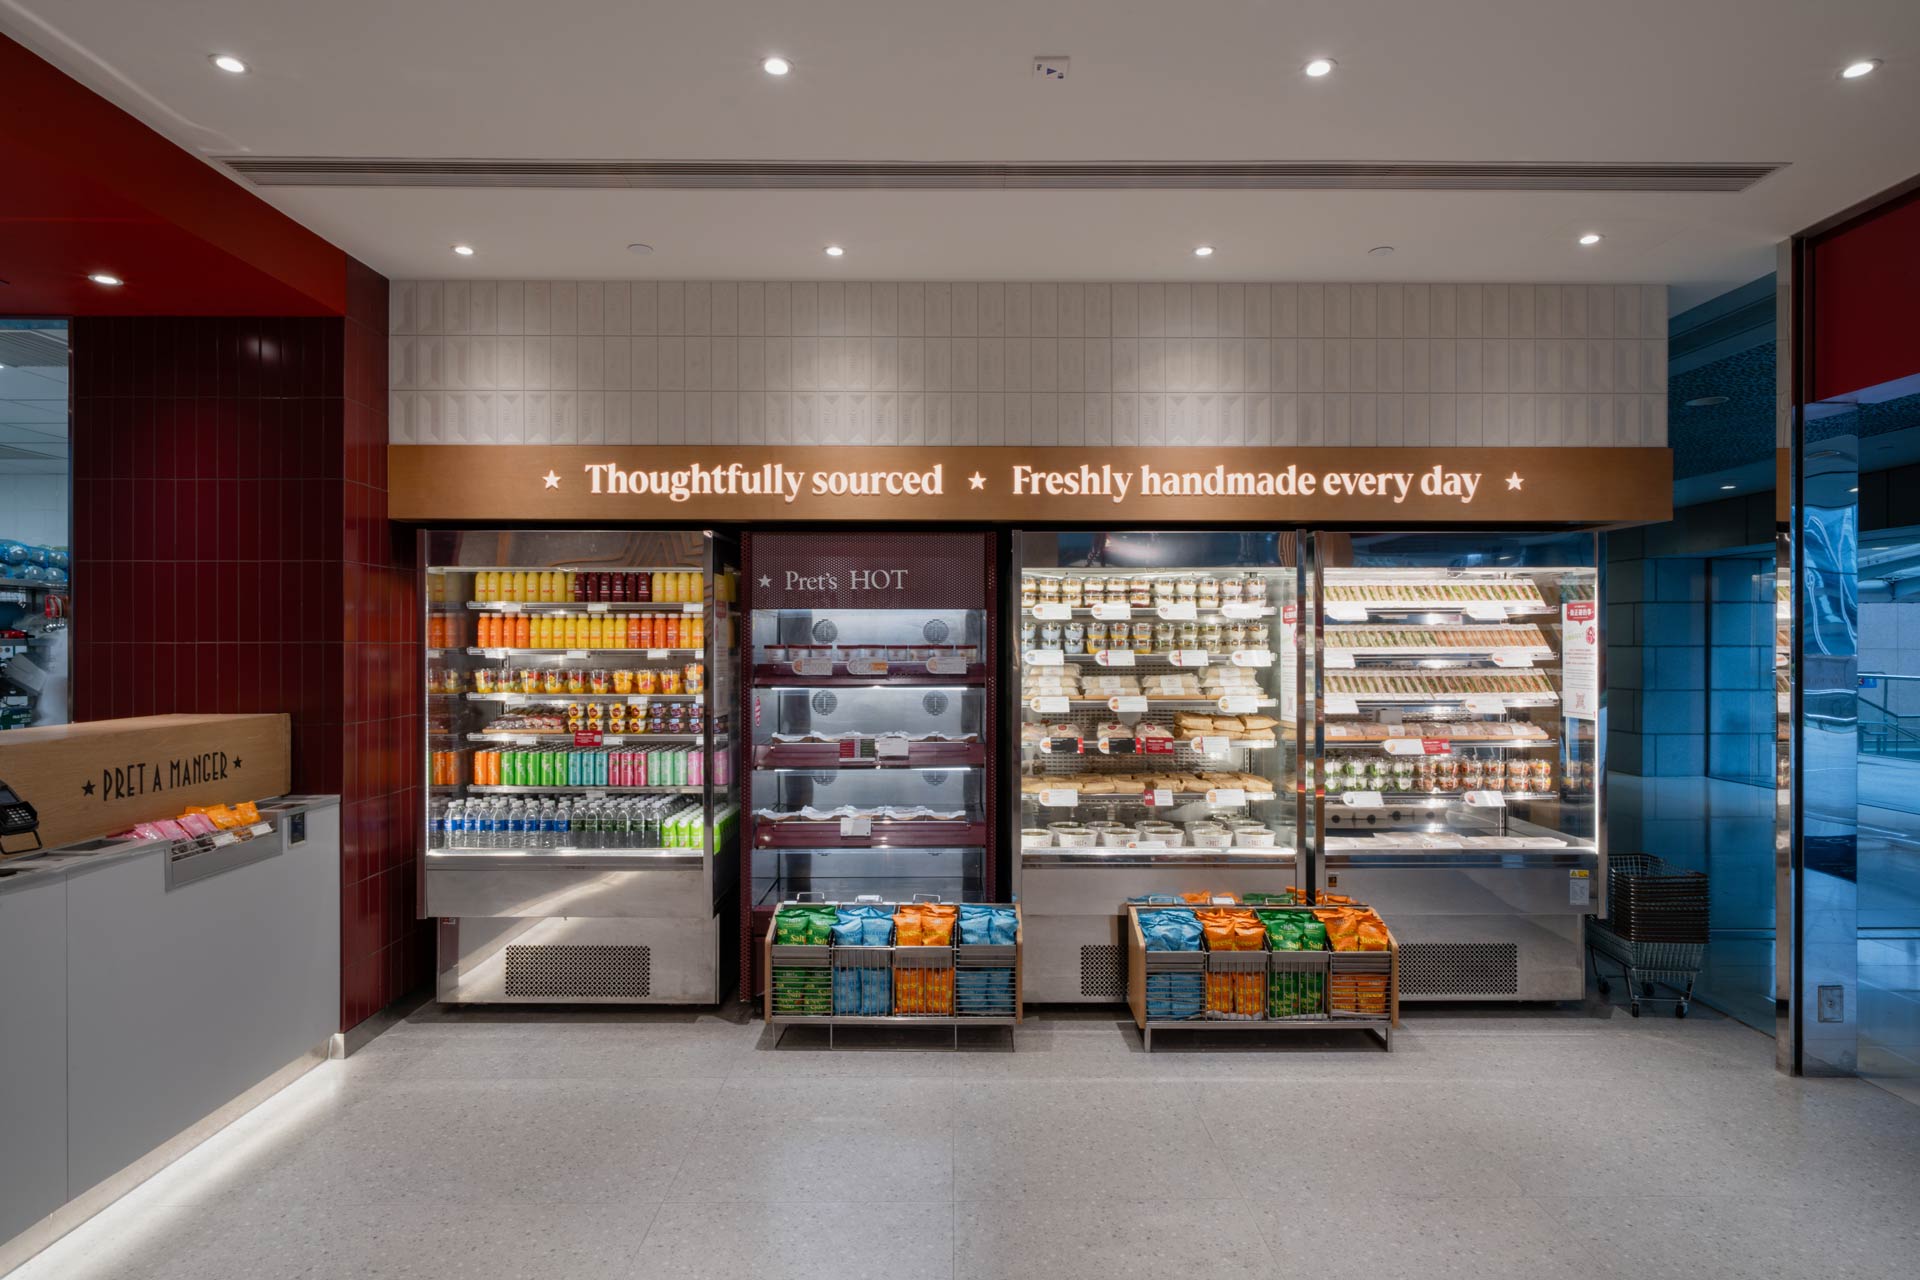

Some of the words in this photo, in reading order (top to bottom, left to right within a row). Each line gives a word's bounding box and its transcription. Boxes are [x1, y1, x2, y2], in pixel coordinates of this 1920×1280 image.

[585, 463, 804, 503] Thoughtfully
[812, 464, 944, 496] sourced
[1012, 464, 1134, 504] Freshly
[1140, 464, 1317, 497] handmade
[1322, 472, 1413, 504] every
[1420, 465, 1483, 504] day
[785, 570, 838, 590] Pret's
[849, 569, 909, 590] HOT
[103, 763, 147, 802] PRET
[152, 764, 162, 793] A
[170, 751, 228, 789] MANGER
